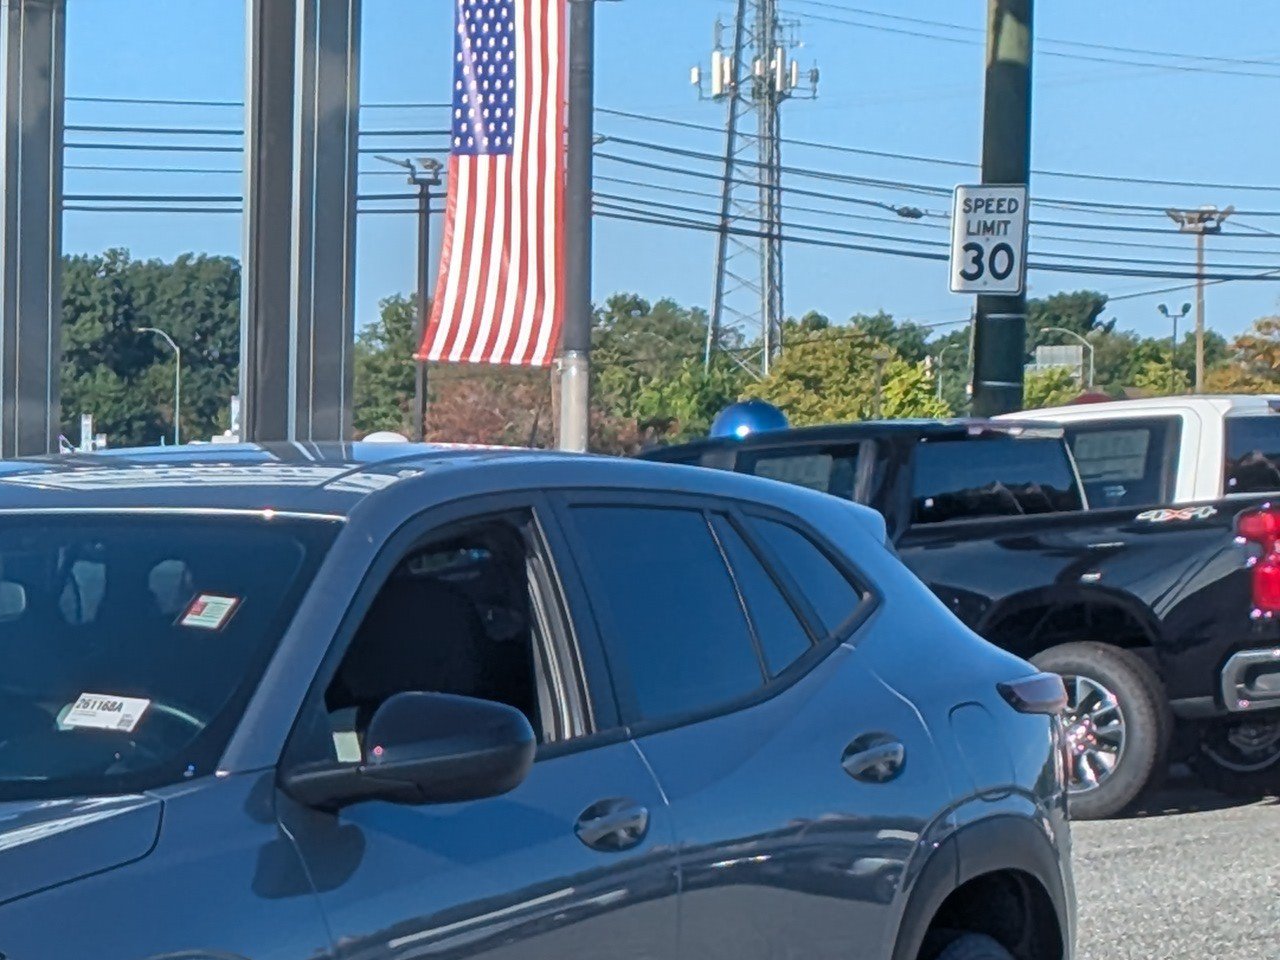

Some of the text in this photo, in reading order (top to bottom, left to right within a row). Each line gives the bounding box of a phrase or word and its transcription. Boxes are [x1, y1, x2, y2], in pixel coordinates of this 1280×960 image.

[962, 197, 1019, 214] SPEED
[966, 219, 1011, 236] LIMIT
[959, 242, 1015, 281] 30
